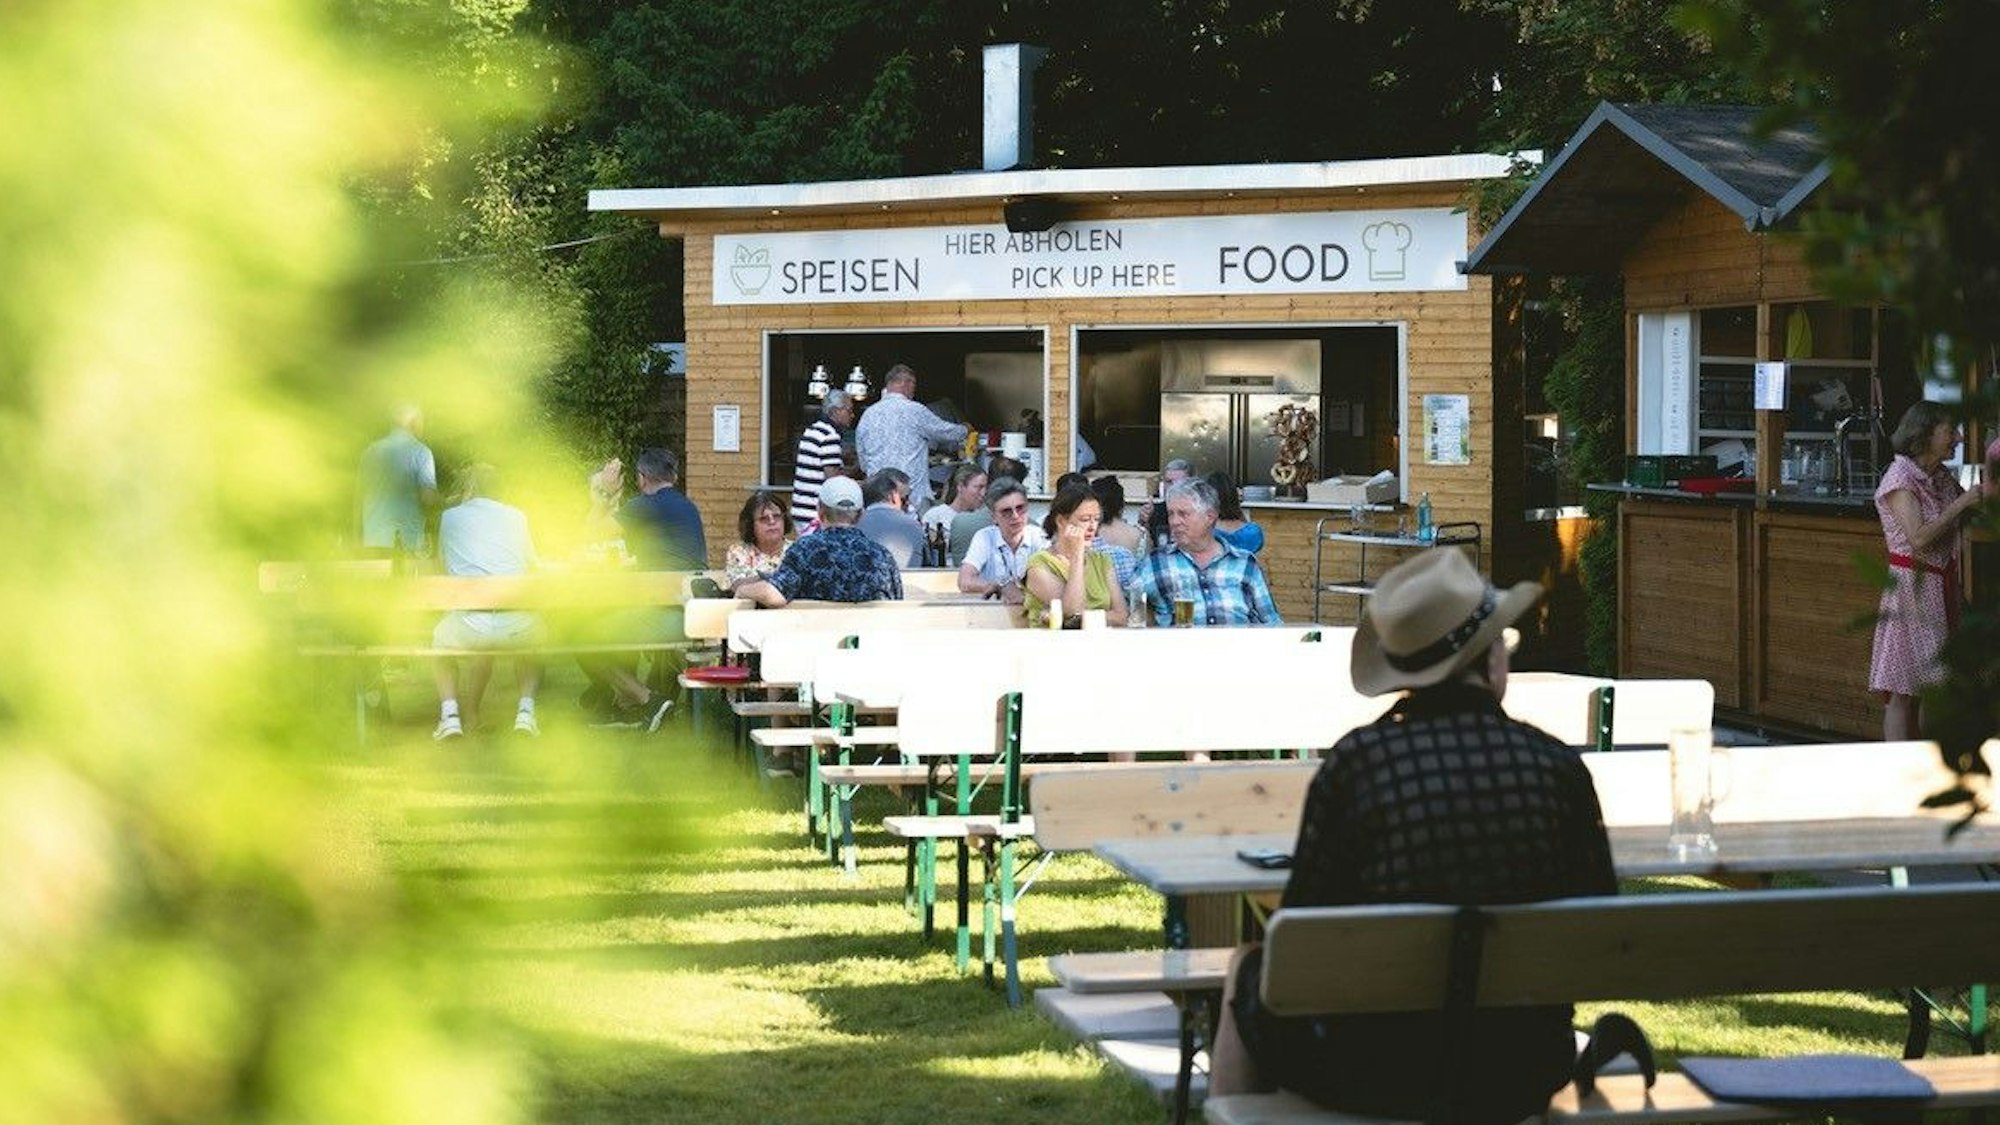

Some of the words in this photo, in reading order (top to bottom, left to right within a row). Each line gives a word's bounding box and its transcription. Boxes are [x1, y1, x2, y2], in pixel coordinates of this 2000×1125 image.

[945, 233, 995, 254] HIER
[1005, 229, 1122, 252] ABHOLEN
[782, 258, 919, 293] SPEISEN
[1012, 265, 1064, 288] PICK
[1074, 265, 1103, 287] UP
[1113, 264, 1176, 286] HERE
[1220, 243, 1349, 283] FOOD
